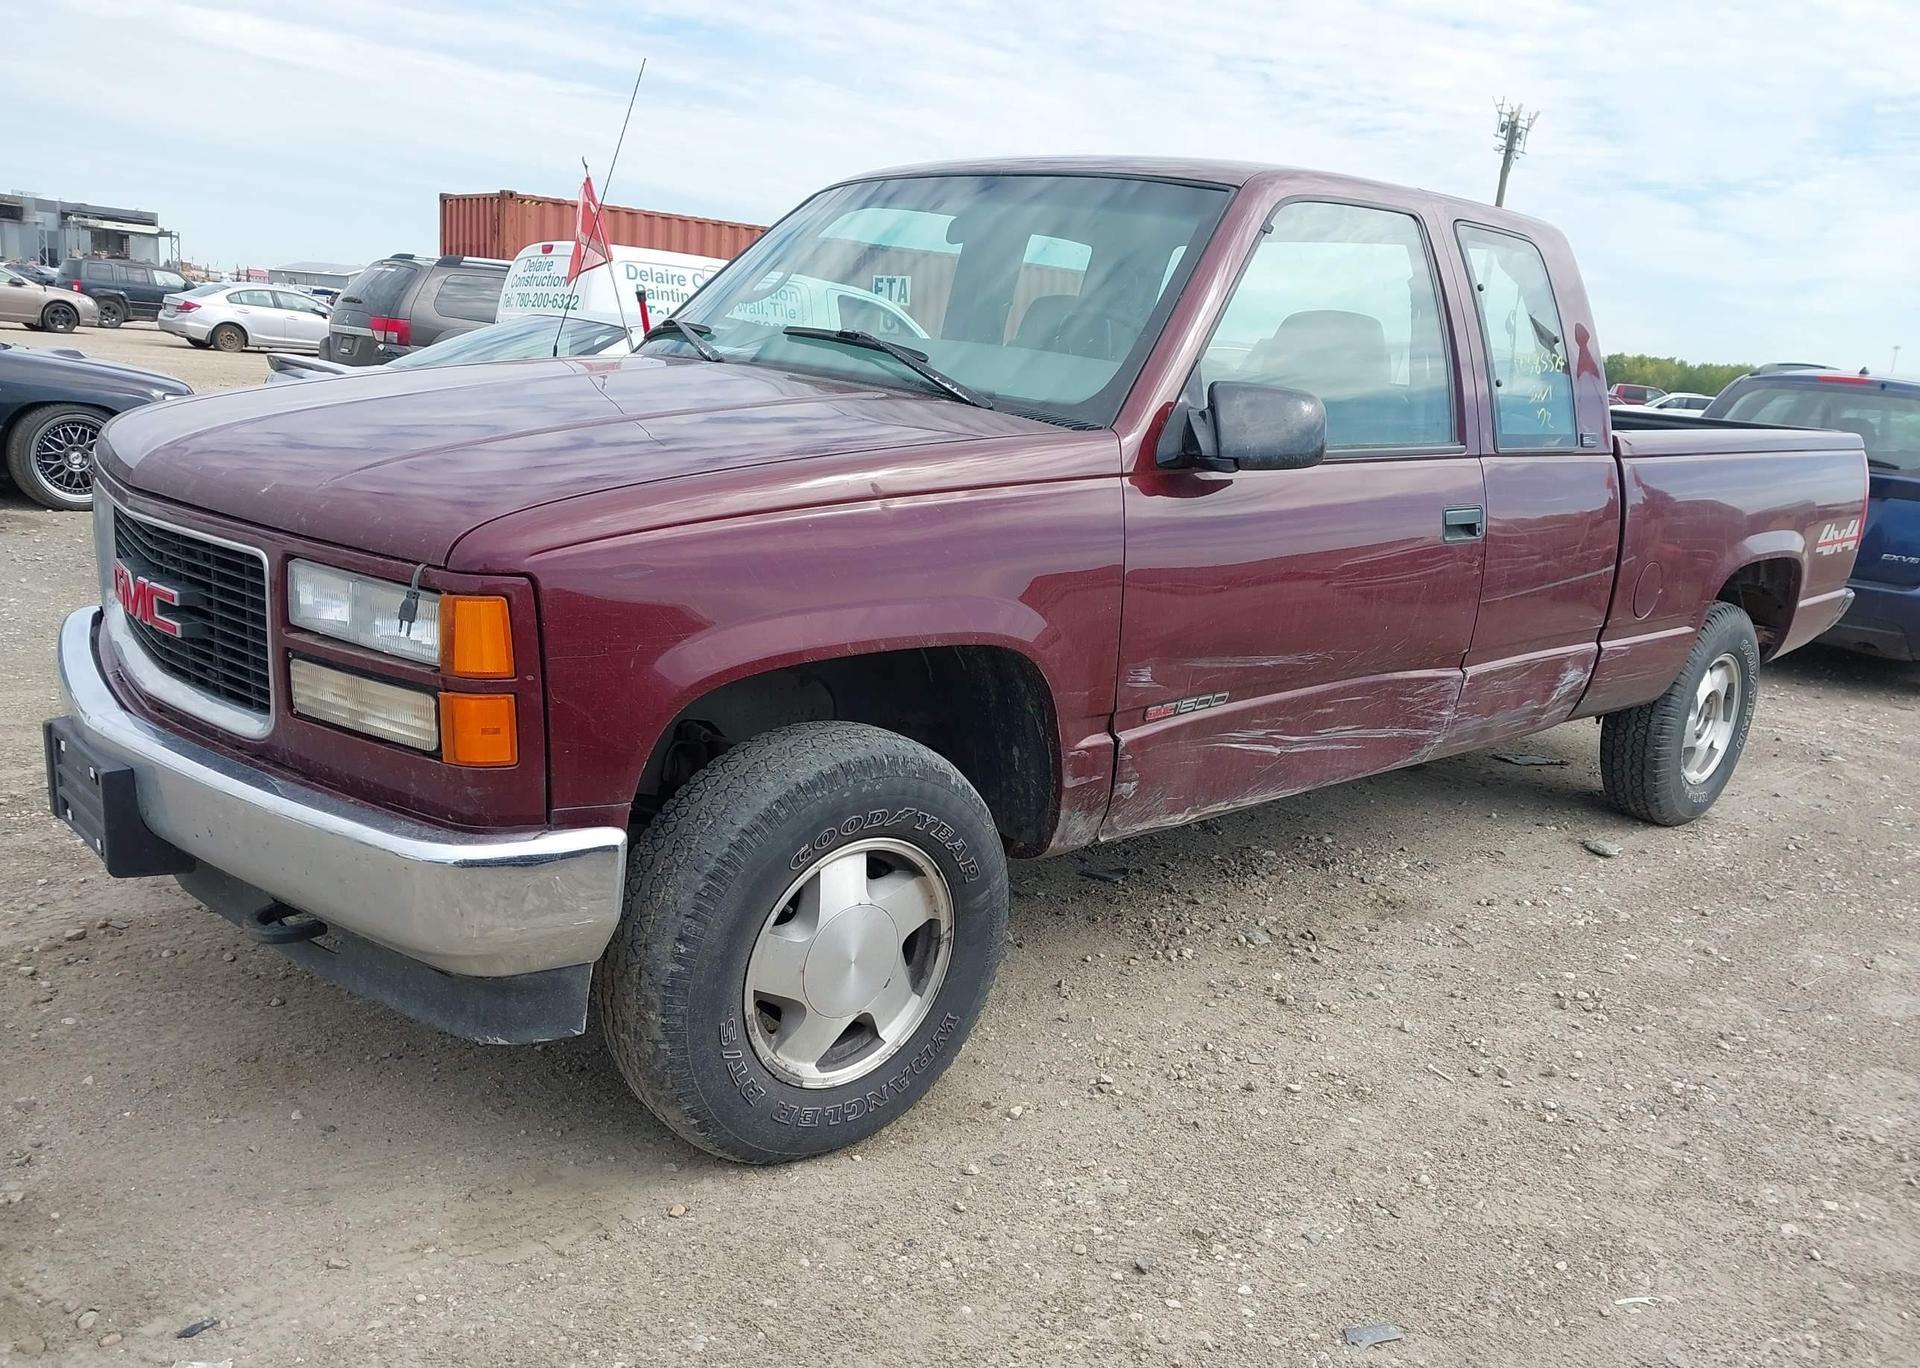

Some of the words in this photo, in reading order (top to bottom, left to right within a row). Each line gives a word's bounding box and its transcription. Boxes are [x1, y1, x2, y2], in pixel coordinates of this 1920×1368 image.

[523, 257, 554, 273] Delaire
[625, 263, 687, 287] Delaire
[511, 272, 567, 289] Construction
[515, 292, 580, 311] 780-200-6322
[112, 558, 182, 638] GMC
[1175, 691, 1230, 715] 1500
[788, 807, 983, 884] GOODYEAR
[770, 1011, 961, 1129] WRANGLER
